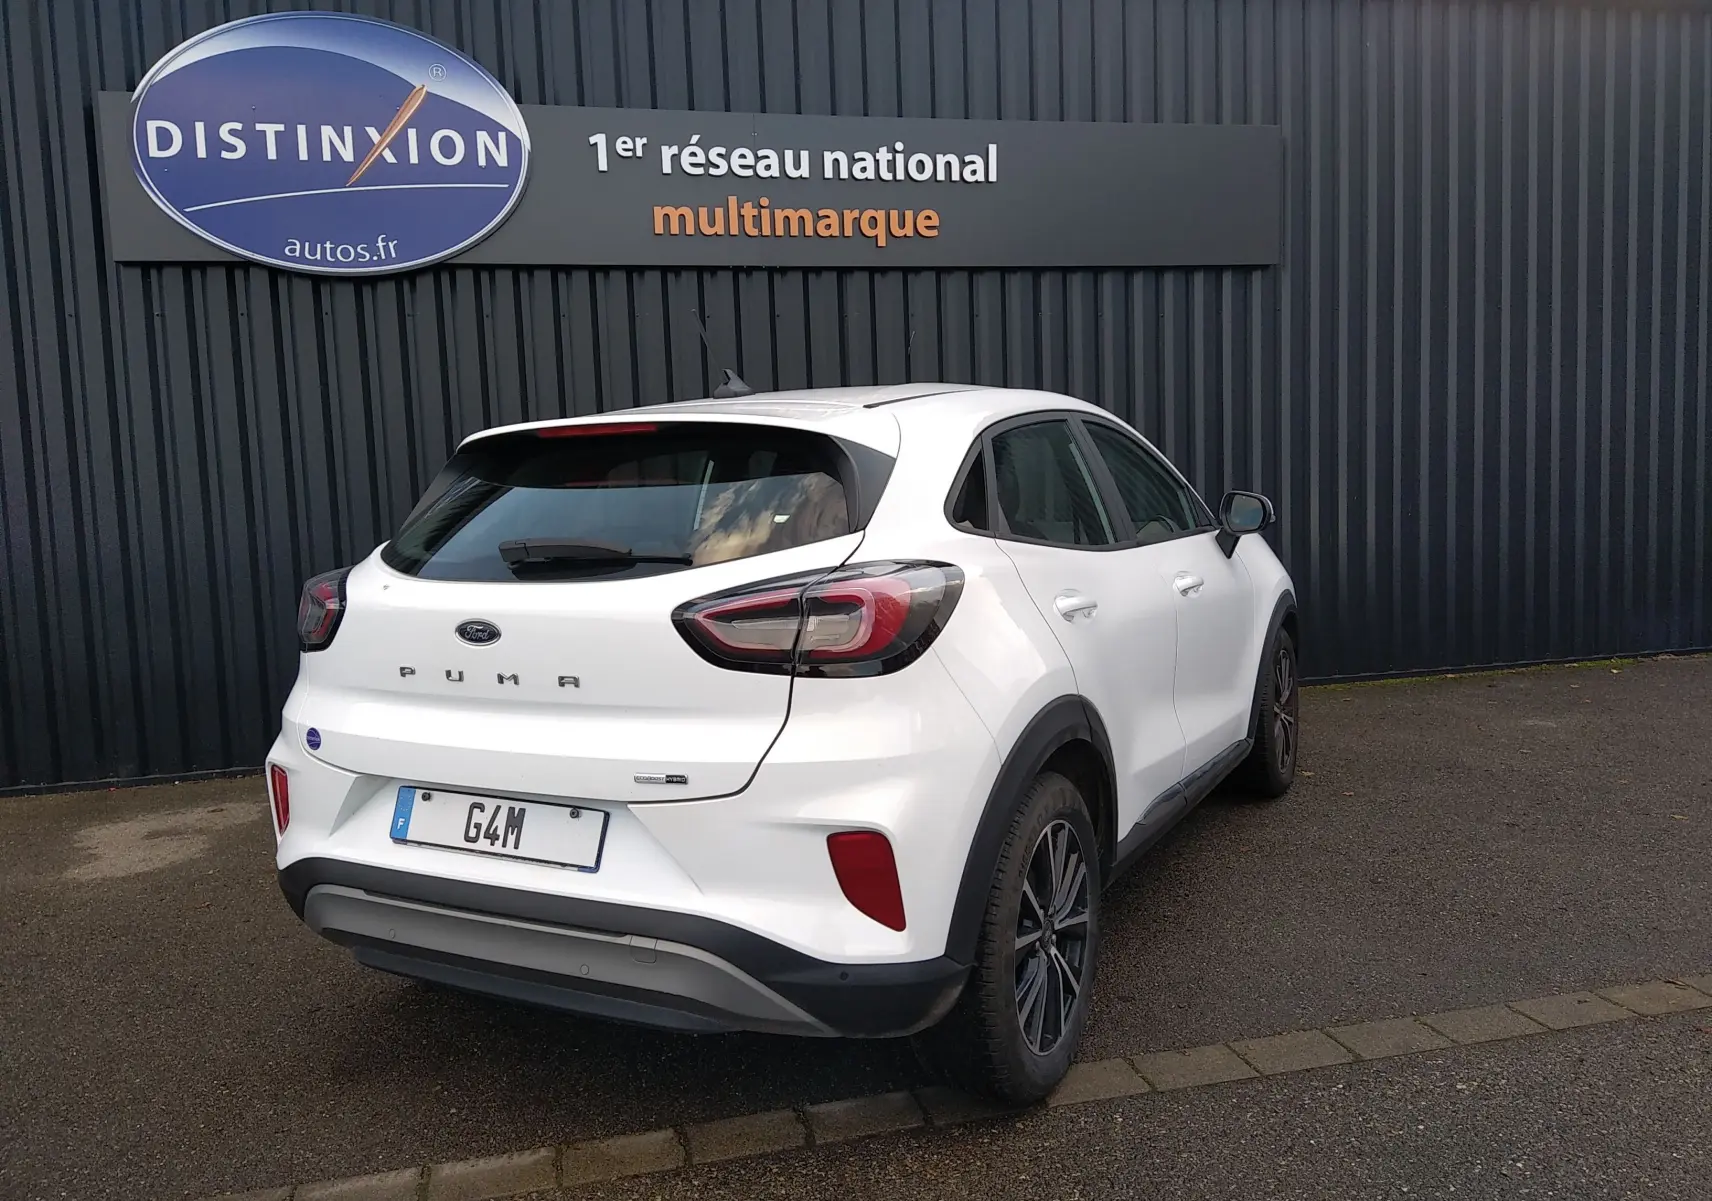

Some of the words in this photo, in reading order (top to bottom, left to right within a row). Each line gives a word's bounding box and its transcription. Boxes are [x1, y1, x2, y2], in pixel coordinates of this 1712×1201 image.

[146, 119, 509, 168] DISTINXION
[588, 132, 647, 172] 1er
[660, 134, 810, 179] réseau
[823, 142, 998, 182] national
[652, 195, 940, 247] multimarque
[284, 234, 398, 263] autos.fr
[464, 624, 490, 640] Ford
[399, 665, 580, 689] PUMA
[397, 818, 405, 830] F
[463, 801, 527, 850] G4M
